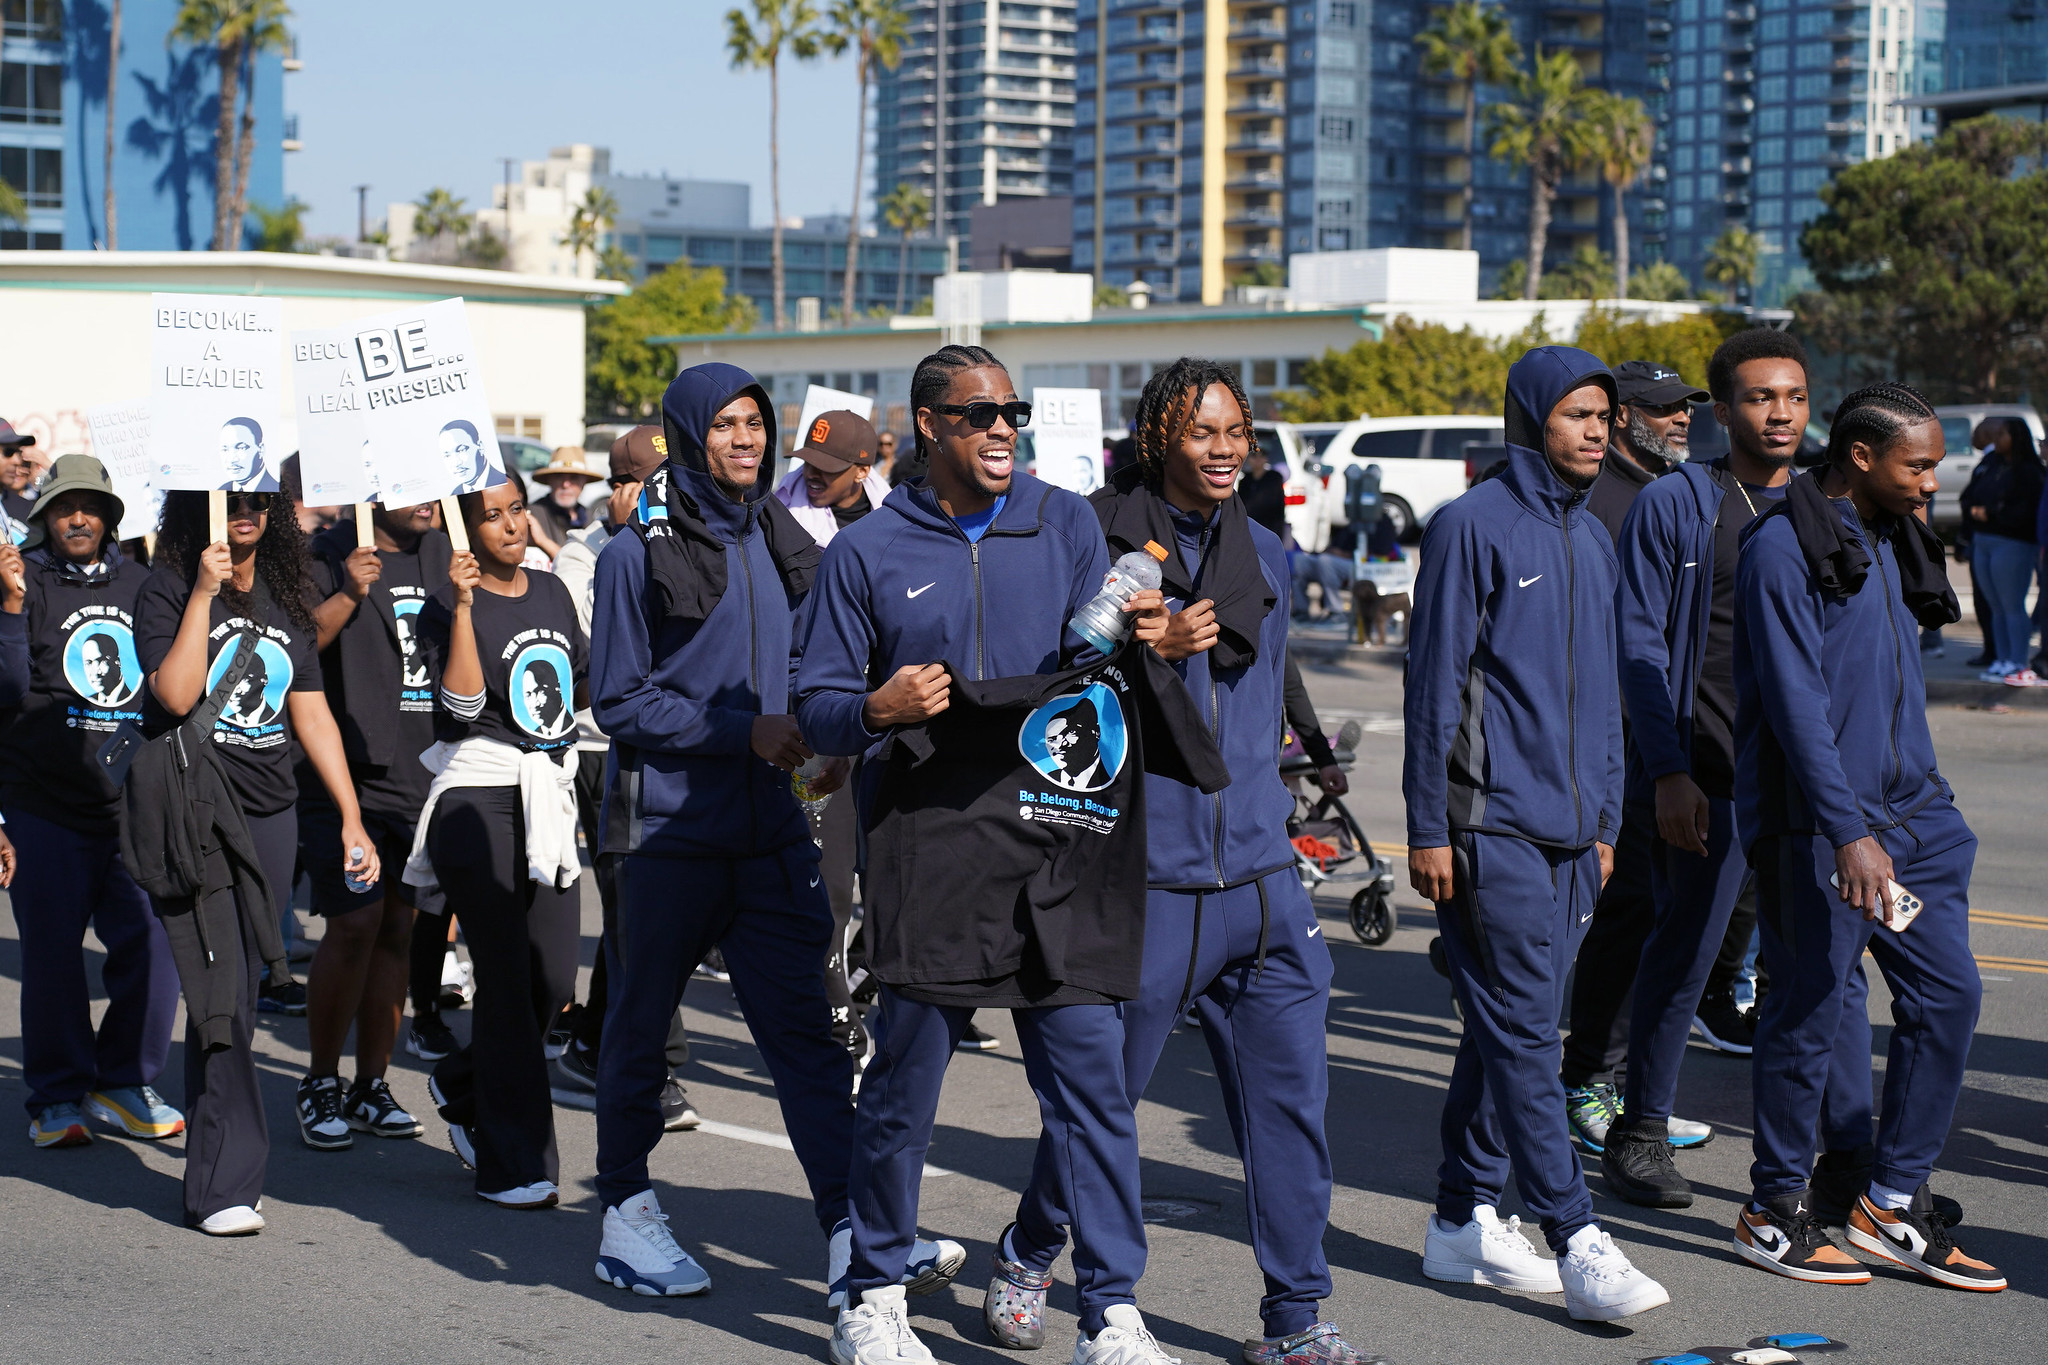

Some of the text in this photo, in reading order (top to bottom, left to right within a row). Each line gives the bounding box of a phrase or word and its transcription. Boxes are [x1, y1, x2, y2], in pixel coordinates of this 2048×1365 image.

[157, 307, 273, 332] BECOME...
[203, 340, 221, 361] A
[166, 366, 263, 389] LEADER
[340, 367, 355, 387] A
[368, 369, 468, 410] PRESENT
[60, 611, 82, 630] THE
[79, 605, 105, 618] TIME
[106, 605, 119, 617] IS
[266, 625, 292, 645] NOW
[501, 639, 519, 660] THE
[514, 628, 539, 645] TIME
[540, 628, 552, 639] IS
[1103, 665, 1130, 693] NOW
[1019, 790, 1120, 818] Be. Belong. Become.
[1034, 806, 1046, 815] San
[1045, 808, 1062, 817] Diego
